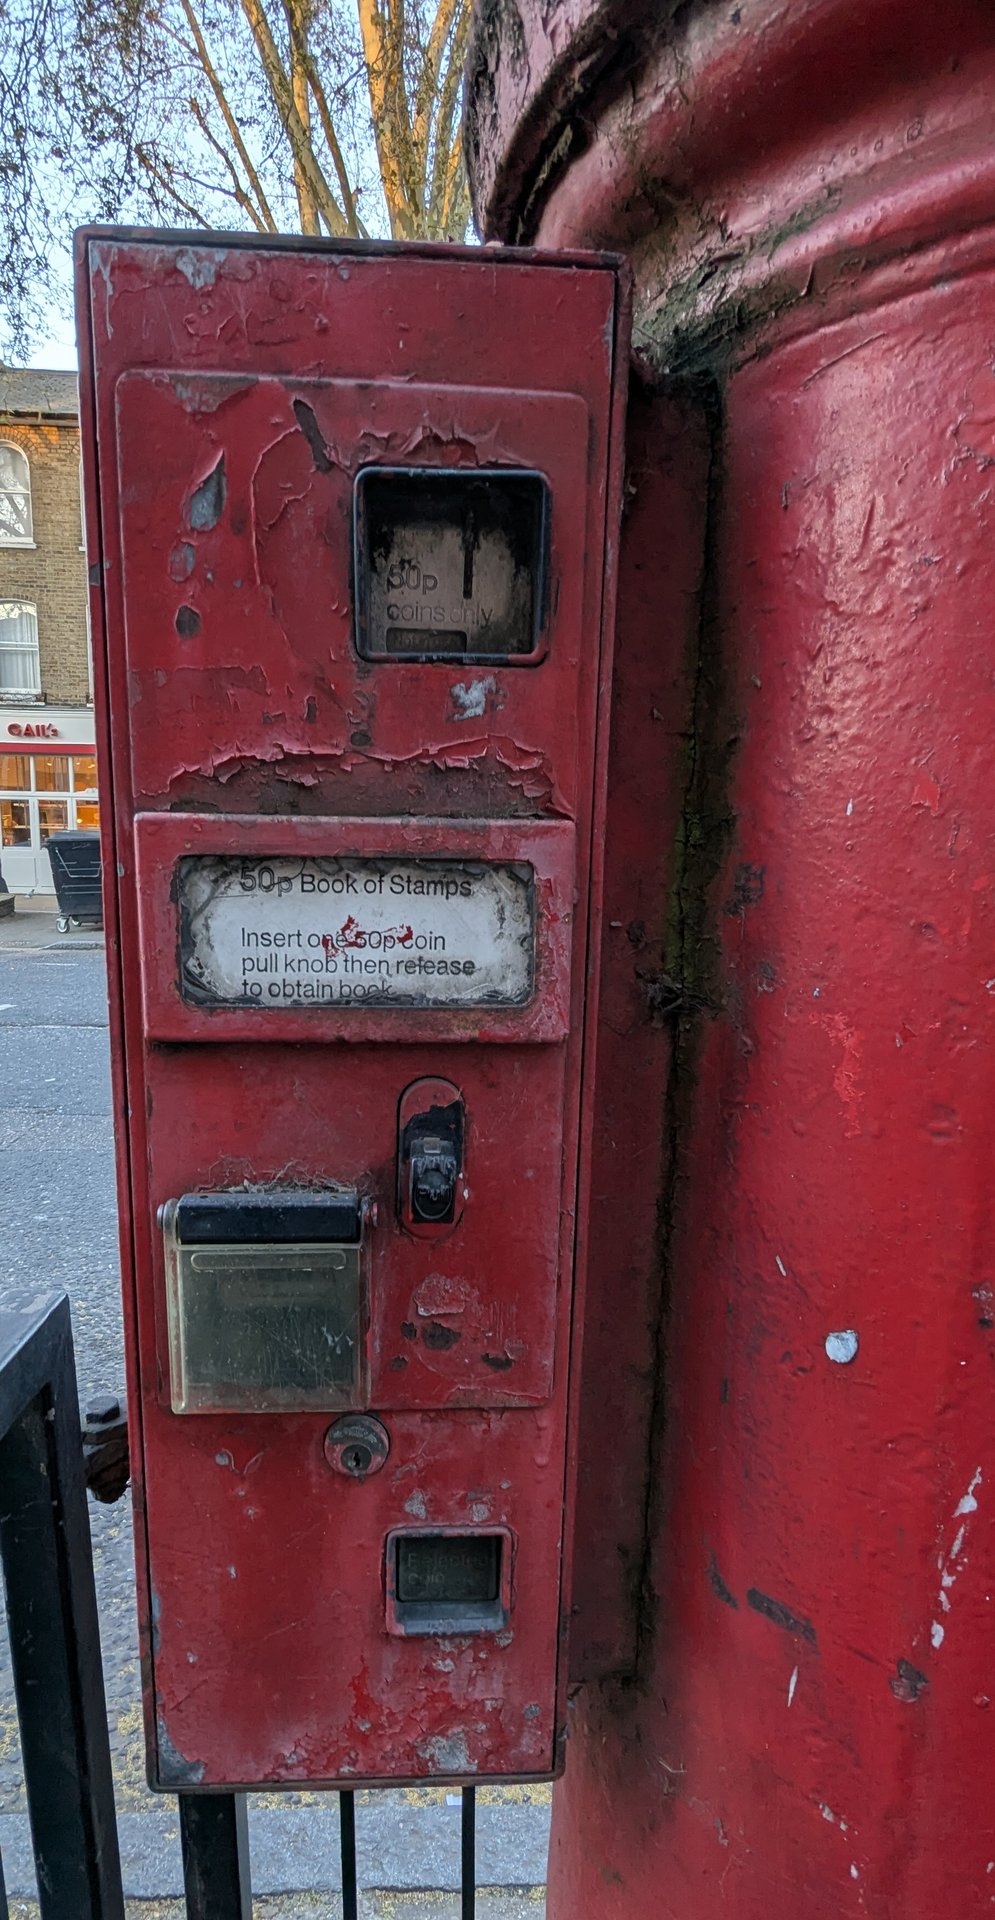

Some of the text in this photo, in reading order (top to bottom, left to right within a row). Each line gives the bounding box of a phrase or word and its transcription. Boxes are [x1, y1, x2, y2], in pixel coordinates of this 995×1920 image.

[387, 562, 438, 595] 50p
[387, 602, 493, 629] coins only
[240, 866, 472, 900] 50p Book of Stamps
[241, 927, 446, 952] Insert one 50p coin
[242, 953, 476, 975] pull knob then release
[242, 979, 393, 998] to obtain book
